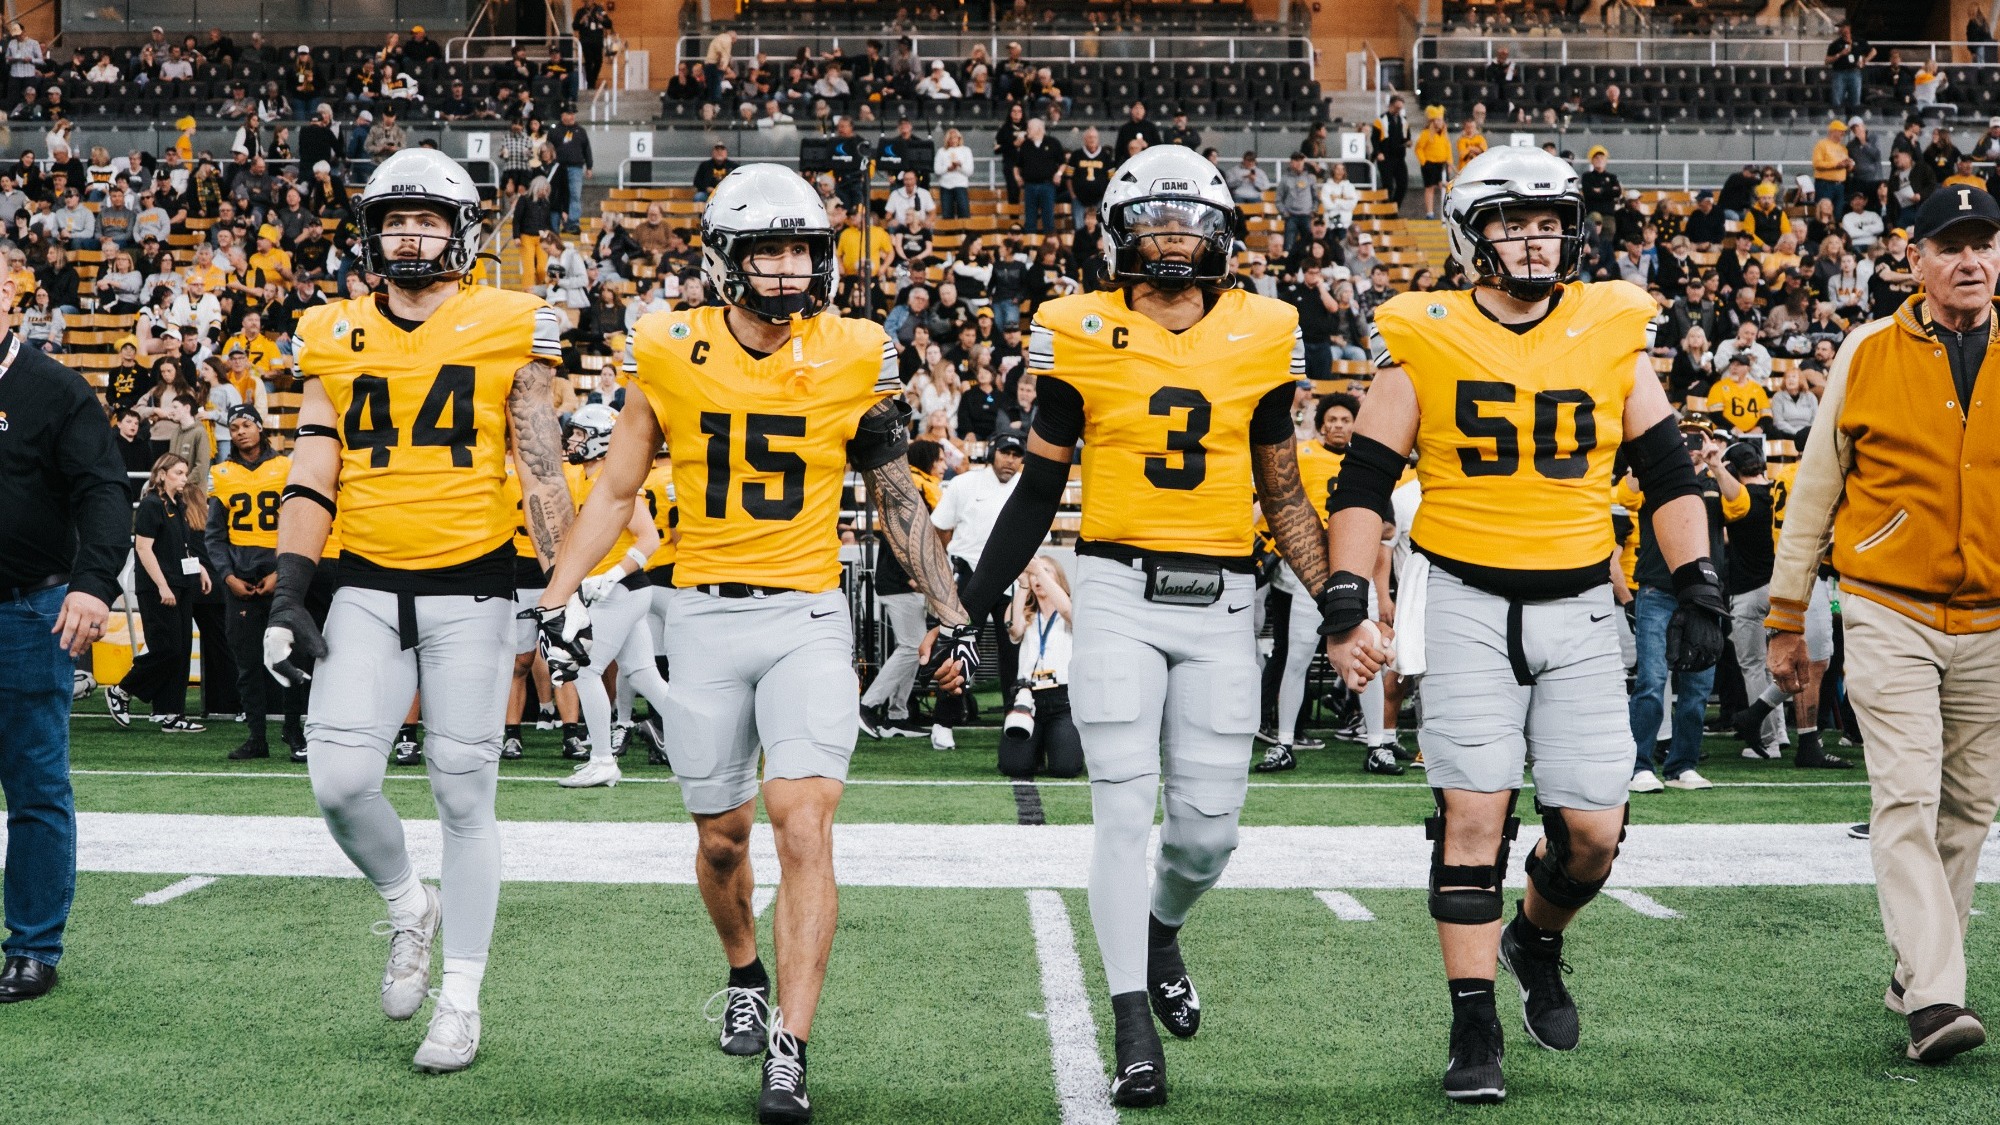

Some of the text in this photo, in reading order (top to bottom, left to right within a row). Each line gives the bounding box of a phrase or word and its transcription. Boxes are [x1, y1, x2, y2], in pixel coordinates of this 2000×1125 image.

[474, 139, 483, 153] 7
[637, 138, 646, 152] 6
[1349, 139, 1358, 154] 6
[391, 184, 417, 193] IDAHO
[1162, 182, 1188, 190] IDAHO
[1957, 189, 1973, 211] I
[780, 218, 806, 228] IDAHO
[351, 328, 365, 352] C
[1112, 327, 1129, 349] C
[690, 340, 711, 365] C
[344, 364, 478, 468] 44
[1731, 397, 1759, 418] 64
[1144, 386, 1212, 491] 3
[1455, 380, 1597, 480] 50
[700, 411, 807, 521] 15
[229, 491, 281, 531] 28
